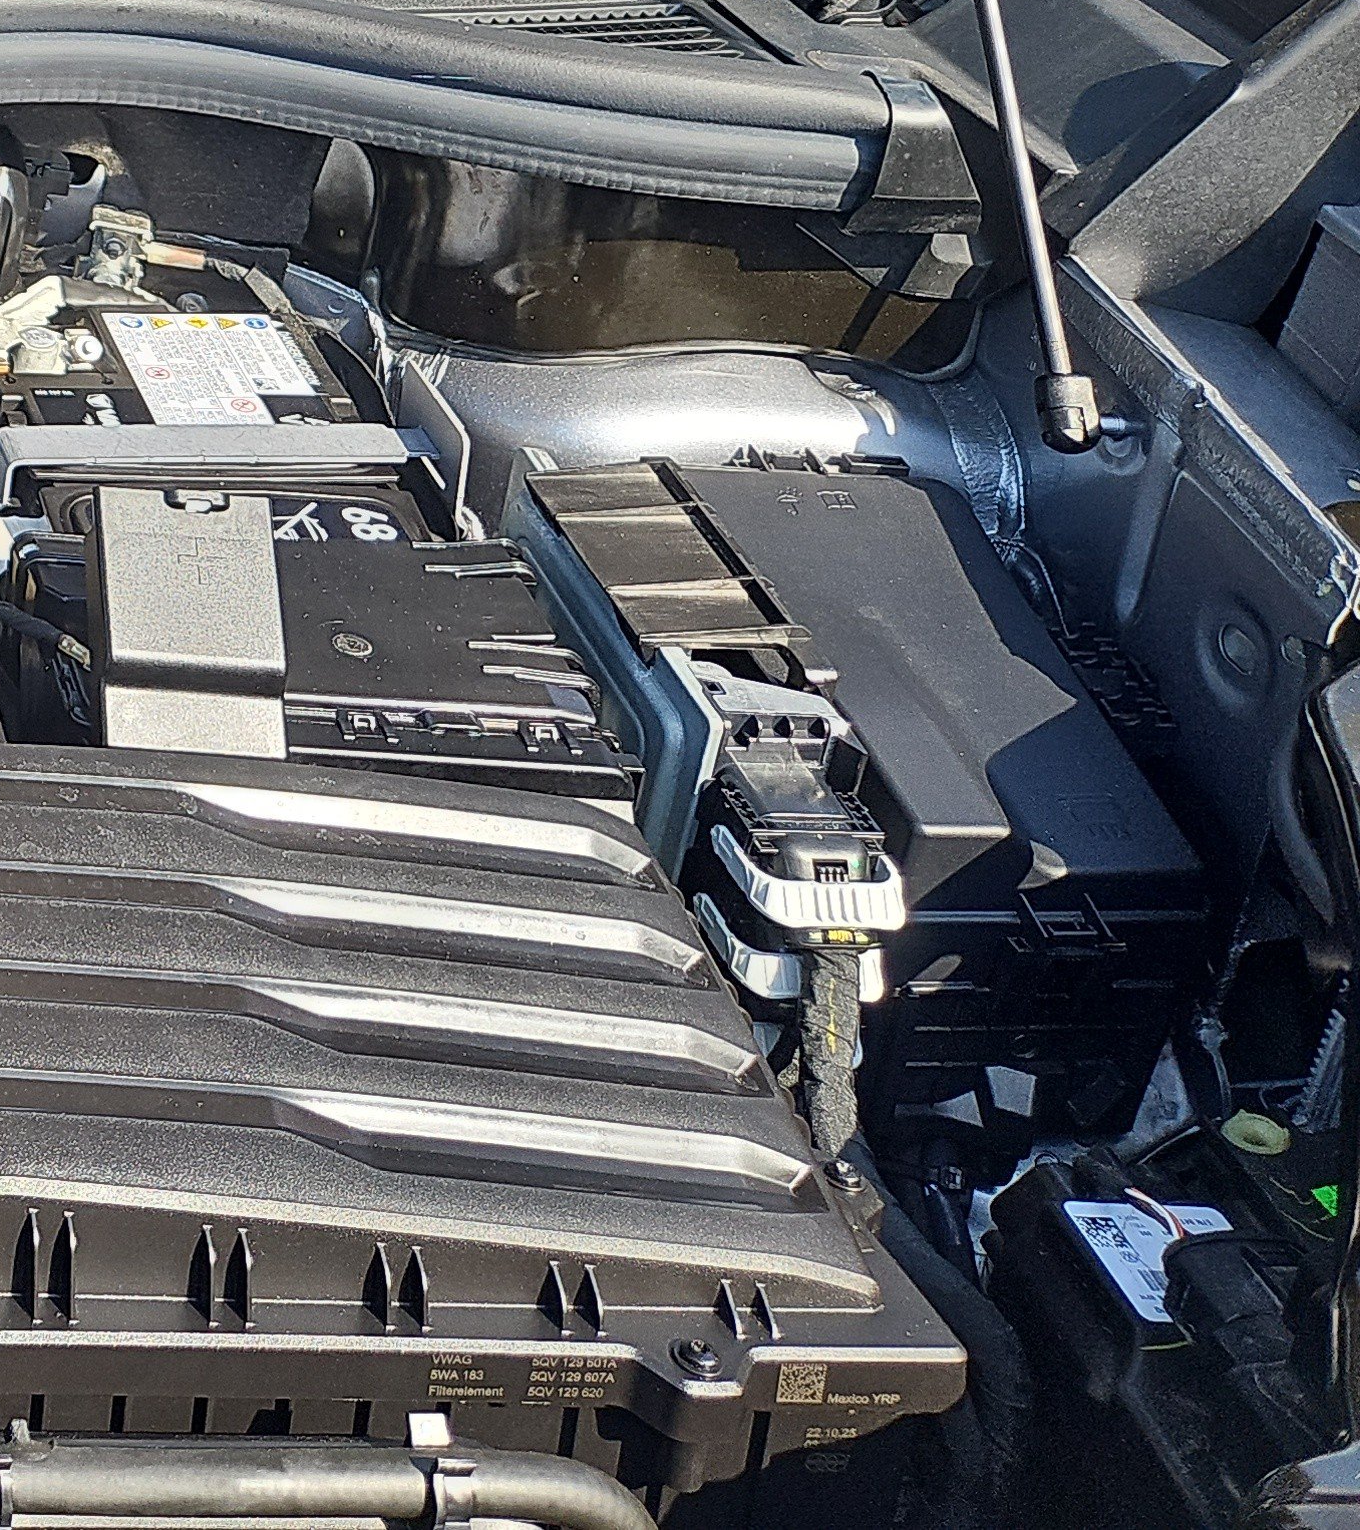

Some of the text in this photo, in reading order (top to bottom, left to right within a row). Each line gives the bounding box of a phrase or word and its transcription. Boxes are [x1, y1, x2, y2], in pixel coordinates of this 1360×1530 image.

[463, 1369, 484, 1380] 183
[561, 1371, 581, 1382] 129
[584, 1372, 616, 1384] 607A
[558, 1387, 578, 1398] 129
[581, 1387, 604, 1398] 620
